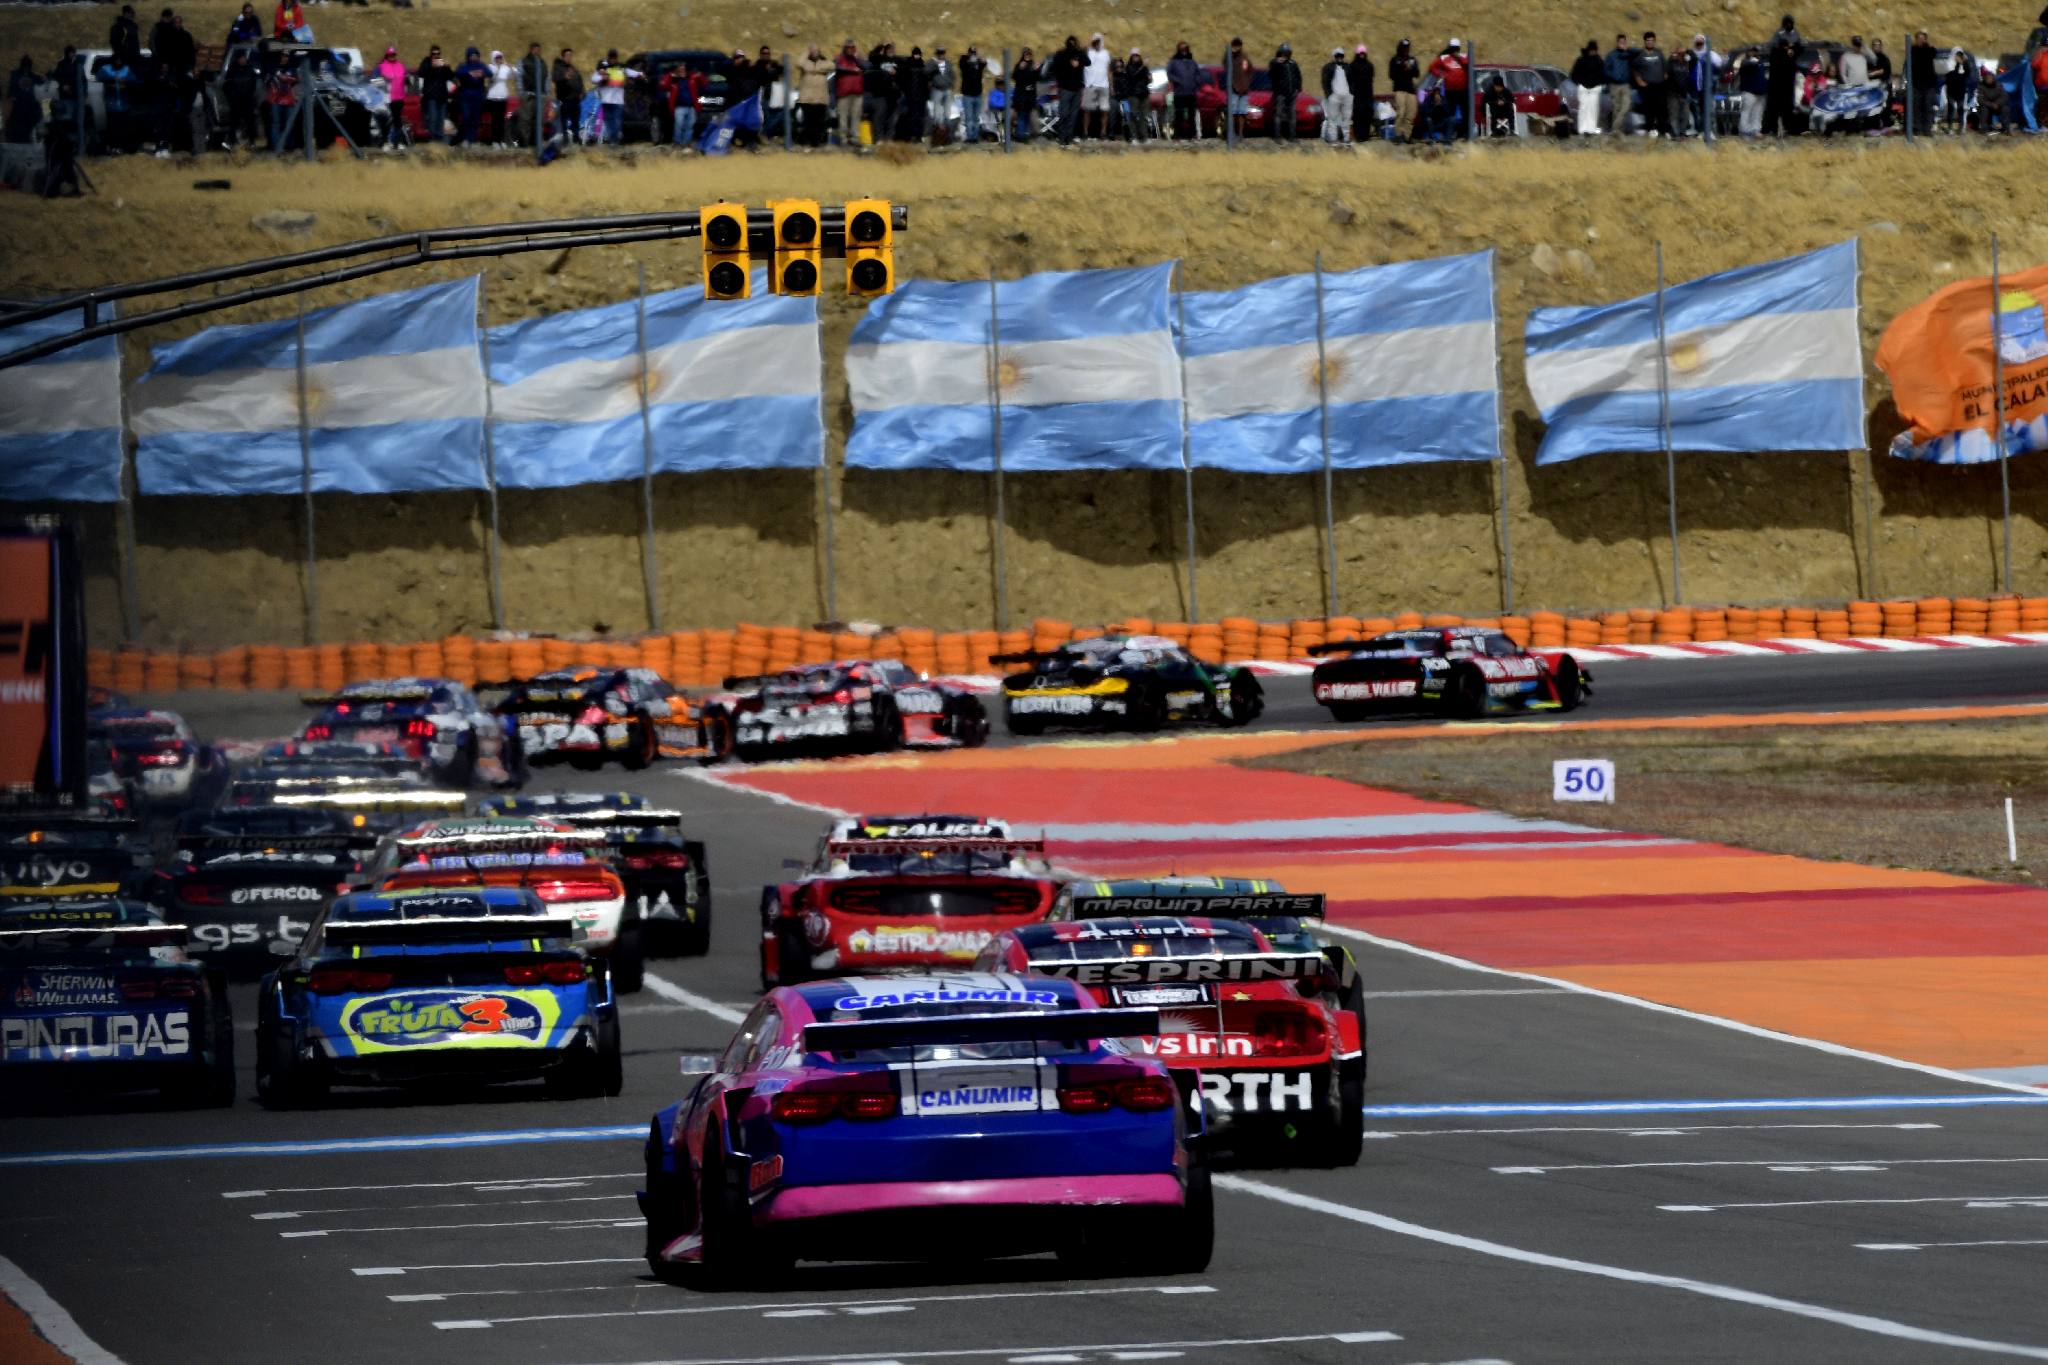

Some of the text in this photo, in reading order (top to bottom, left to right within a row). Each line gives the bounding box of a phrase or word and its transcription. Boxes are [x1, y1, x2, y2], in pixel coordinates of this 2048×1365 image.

[1964, 402, 1989, 421] EL
[1564, 767, 1604, 793] 50
[250, 886, 322, 901] FERCOL
[1207, 897, 1313, 909] PARTS
[39, 974, 115, 990] SHERWIN
[459, 997, 512, 1033] 3
[1, 1012, 190, 1060] PINTURAS
[1186, 1034, 1253, 1056] Inn
